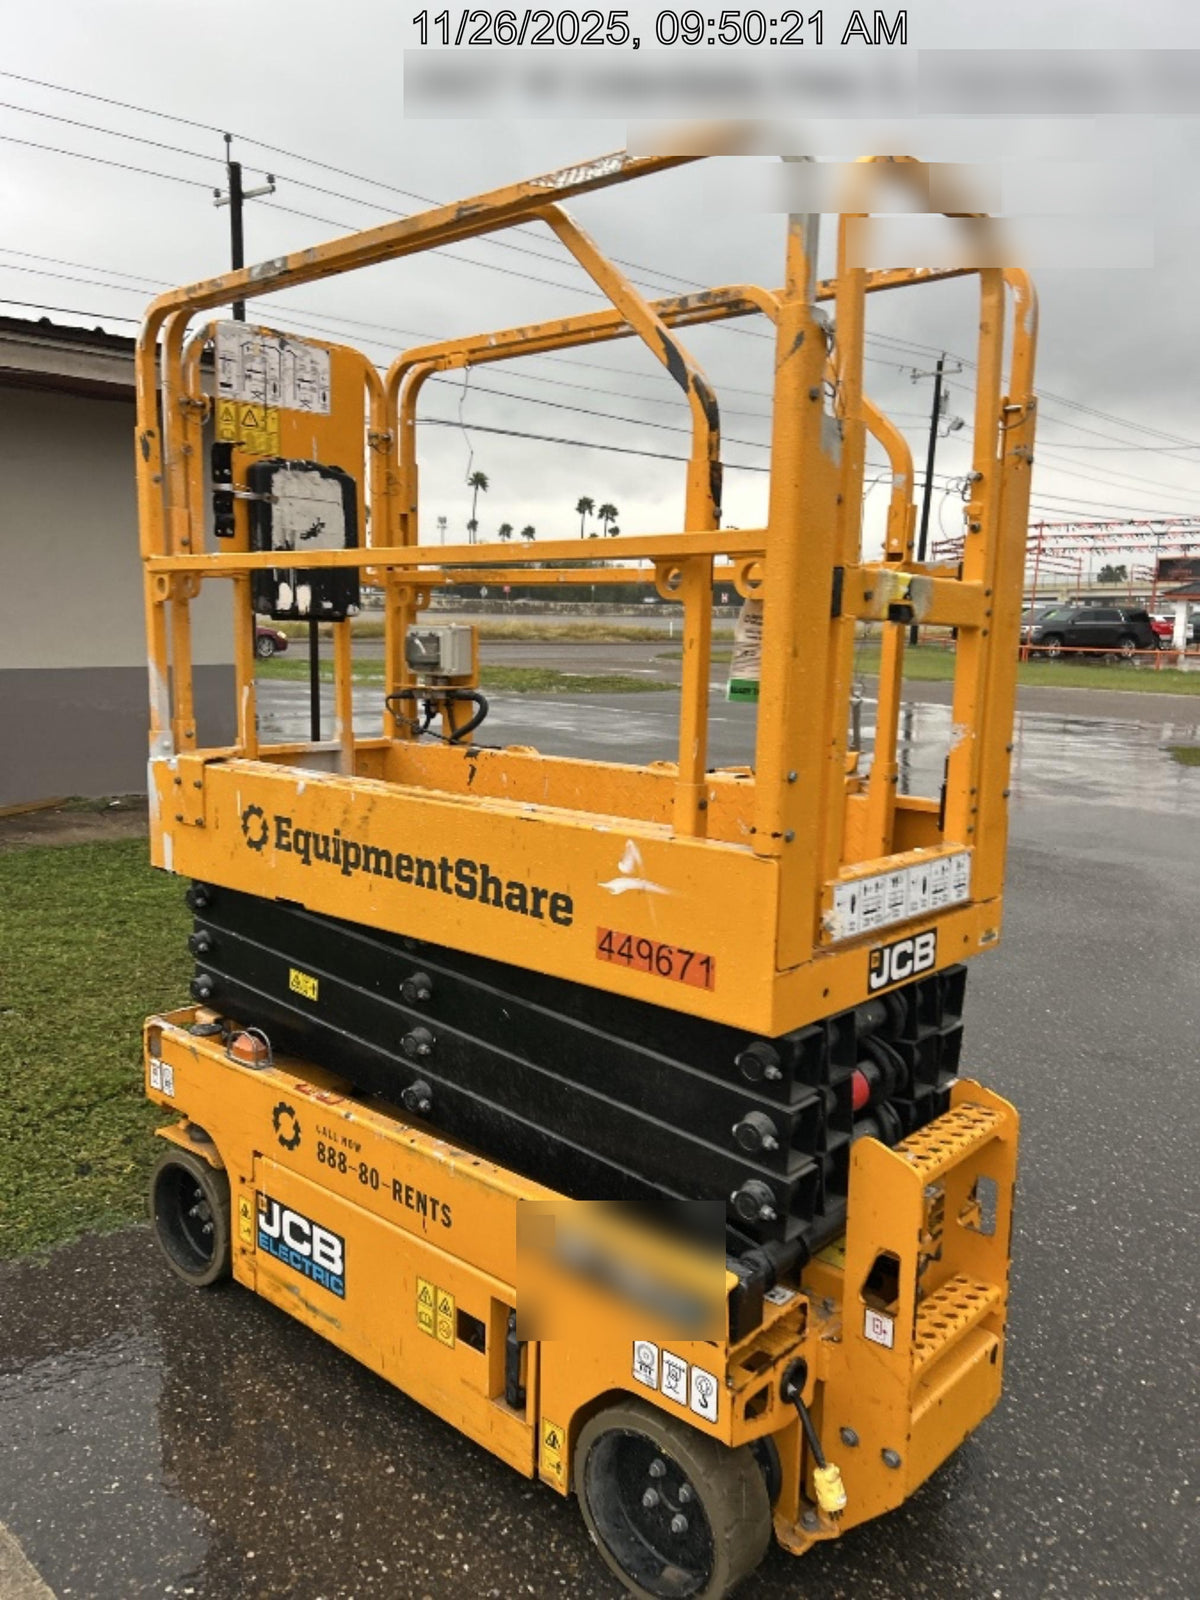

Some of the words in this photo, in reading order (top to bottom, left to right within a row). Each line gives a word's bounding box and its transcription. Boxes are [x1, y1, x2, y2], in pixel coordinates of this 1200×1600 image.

[273, 815, 574, 927] EquipmentShare
[598, 929, 713, 988] 449671
[869, 931, 936, 990] JCB
[316, 1140, 452, 1229] 888-80-RENTS
[258, 1201, 343, 1275] JCB
[258, 1231, 344, 1296] ELECTRIC
